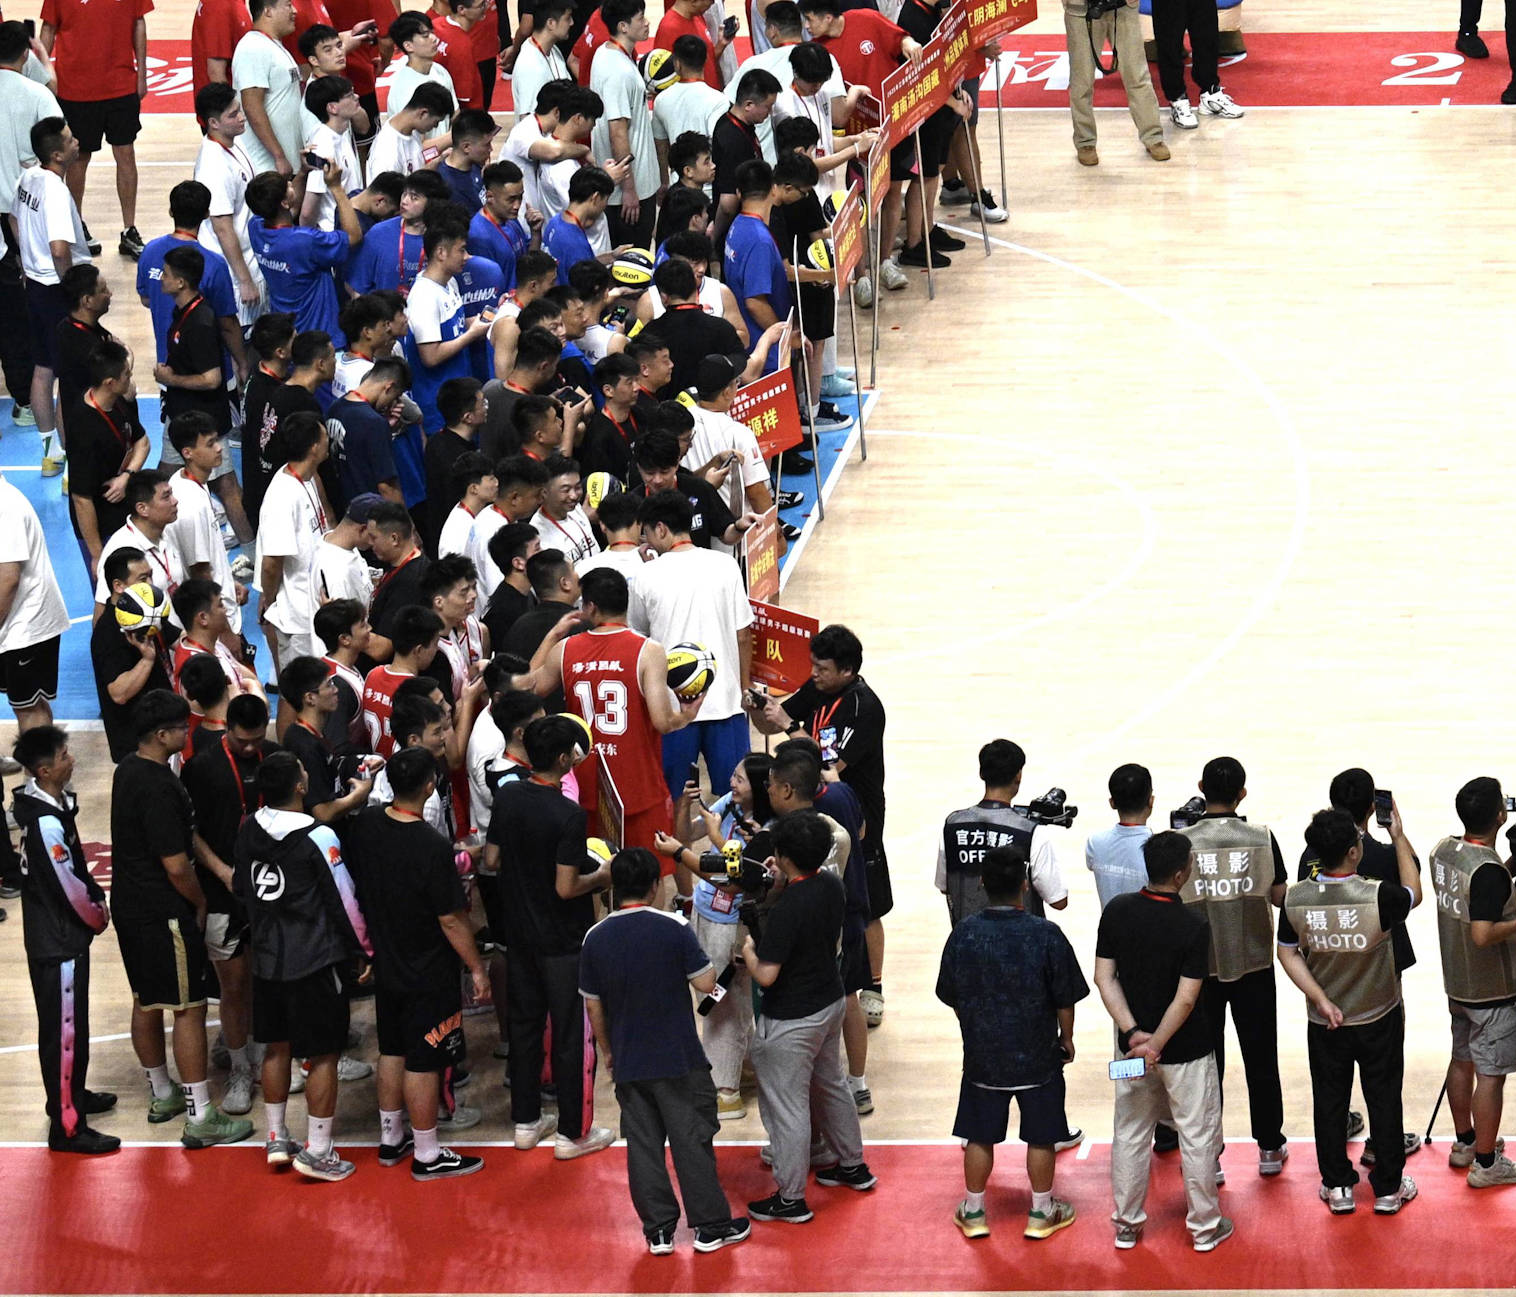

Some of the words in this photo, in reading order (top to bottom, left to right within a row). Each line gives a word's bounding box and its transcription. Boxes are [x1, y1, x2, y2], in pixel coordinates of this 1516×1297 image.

[574, 679, 628, 735] 13
[1197, 851, 1250, 876] 摄影
[1194, 875, 1255, 899] PHOTO
[1305, 907, 1360, 933] 摄影
[1305, 930, 1368, 951] PHOTO
